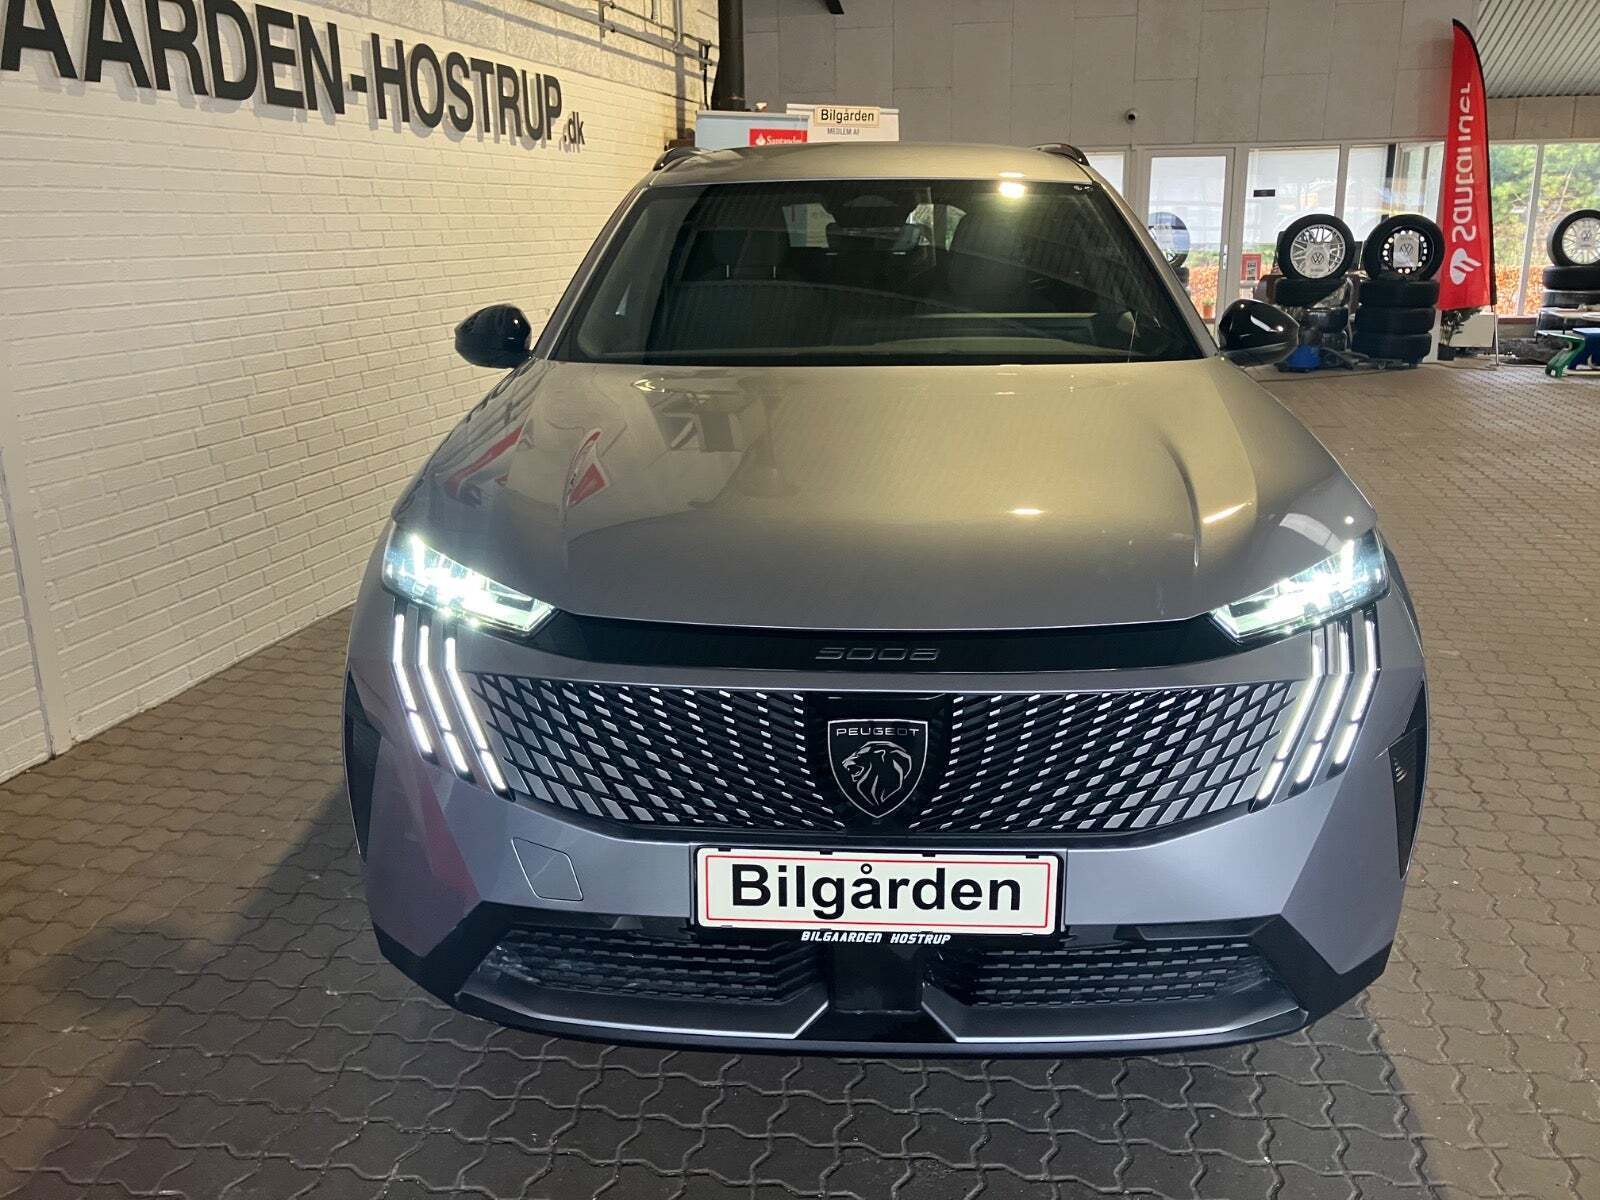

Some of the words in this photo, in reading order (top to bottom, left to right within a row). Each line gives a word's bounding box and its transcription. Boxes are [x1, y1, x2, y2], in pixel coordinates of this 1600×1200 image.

[821, 108, 874, 123] Bilgården
[815, 647, 939, 661] 5008
[836, 727, 919, 736] PEUGEOT
[732, 863, 1021, 920] Bilgården
[801, 931, 882, 943] BILGAARDEN
[890, 933, 951, 945] HOSTRUP
